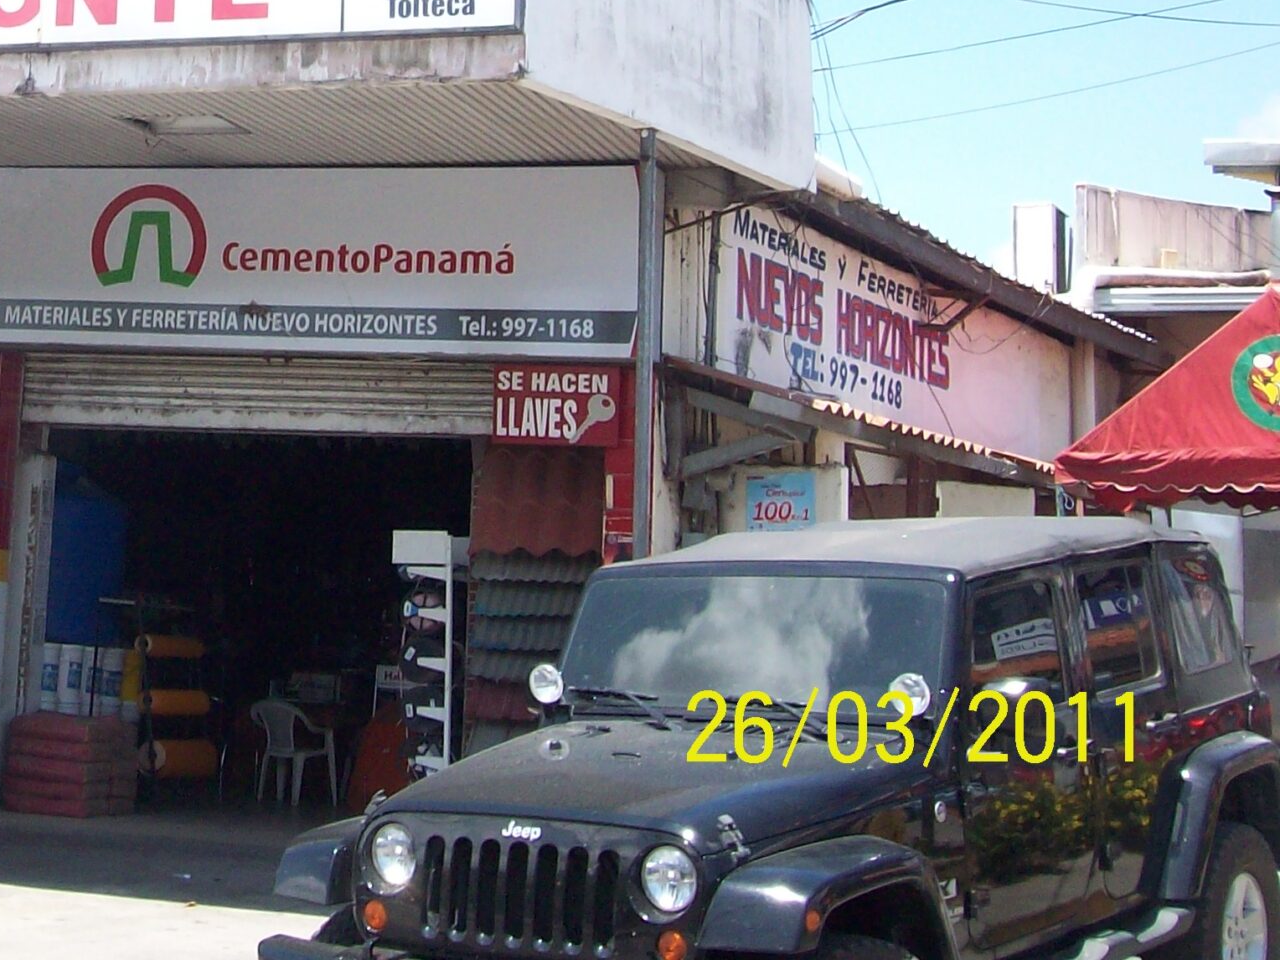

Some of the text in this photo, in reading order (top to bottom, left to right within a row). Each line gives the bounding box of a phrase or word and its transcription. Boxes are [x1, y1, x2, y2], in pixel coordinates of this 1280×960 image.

[733, 208, 827, 271] MATERIALES
[222, 241, 515, 274] CementoPanamá
[5, 304, 112, 327] MATERIALES
[116, 308, 128, 327] Y
[132, 306, 238, 331] FERRETERÍA
[243, 311, 310, 333] NUEVO
[314, 313, 438, 336] HORIZONTES
[502, 317, 595, 339] 997-1168
[497, 371, 608, 393] SE HACEN
[829, 356, 903, 410] 997-1168
[496, 397, 577, 440] LLAVES
[752, 501, 792, 521] 100
[501, 820, 541, 841] Jeep
